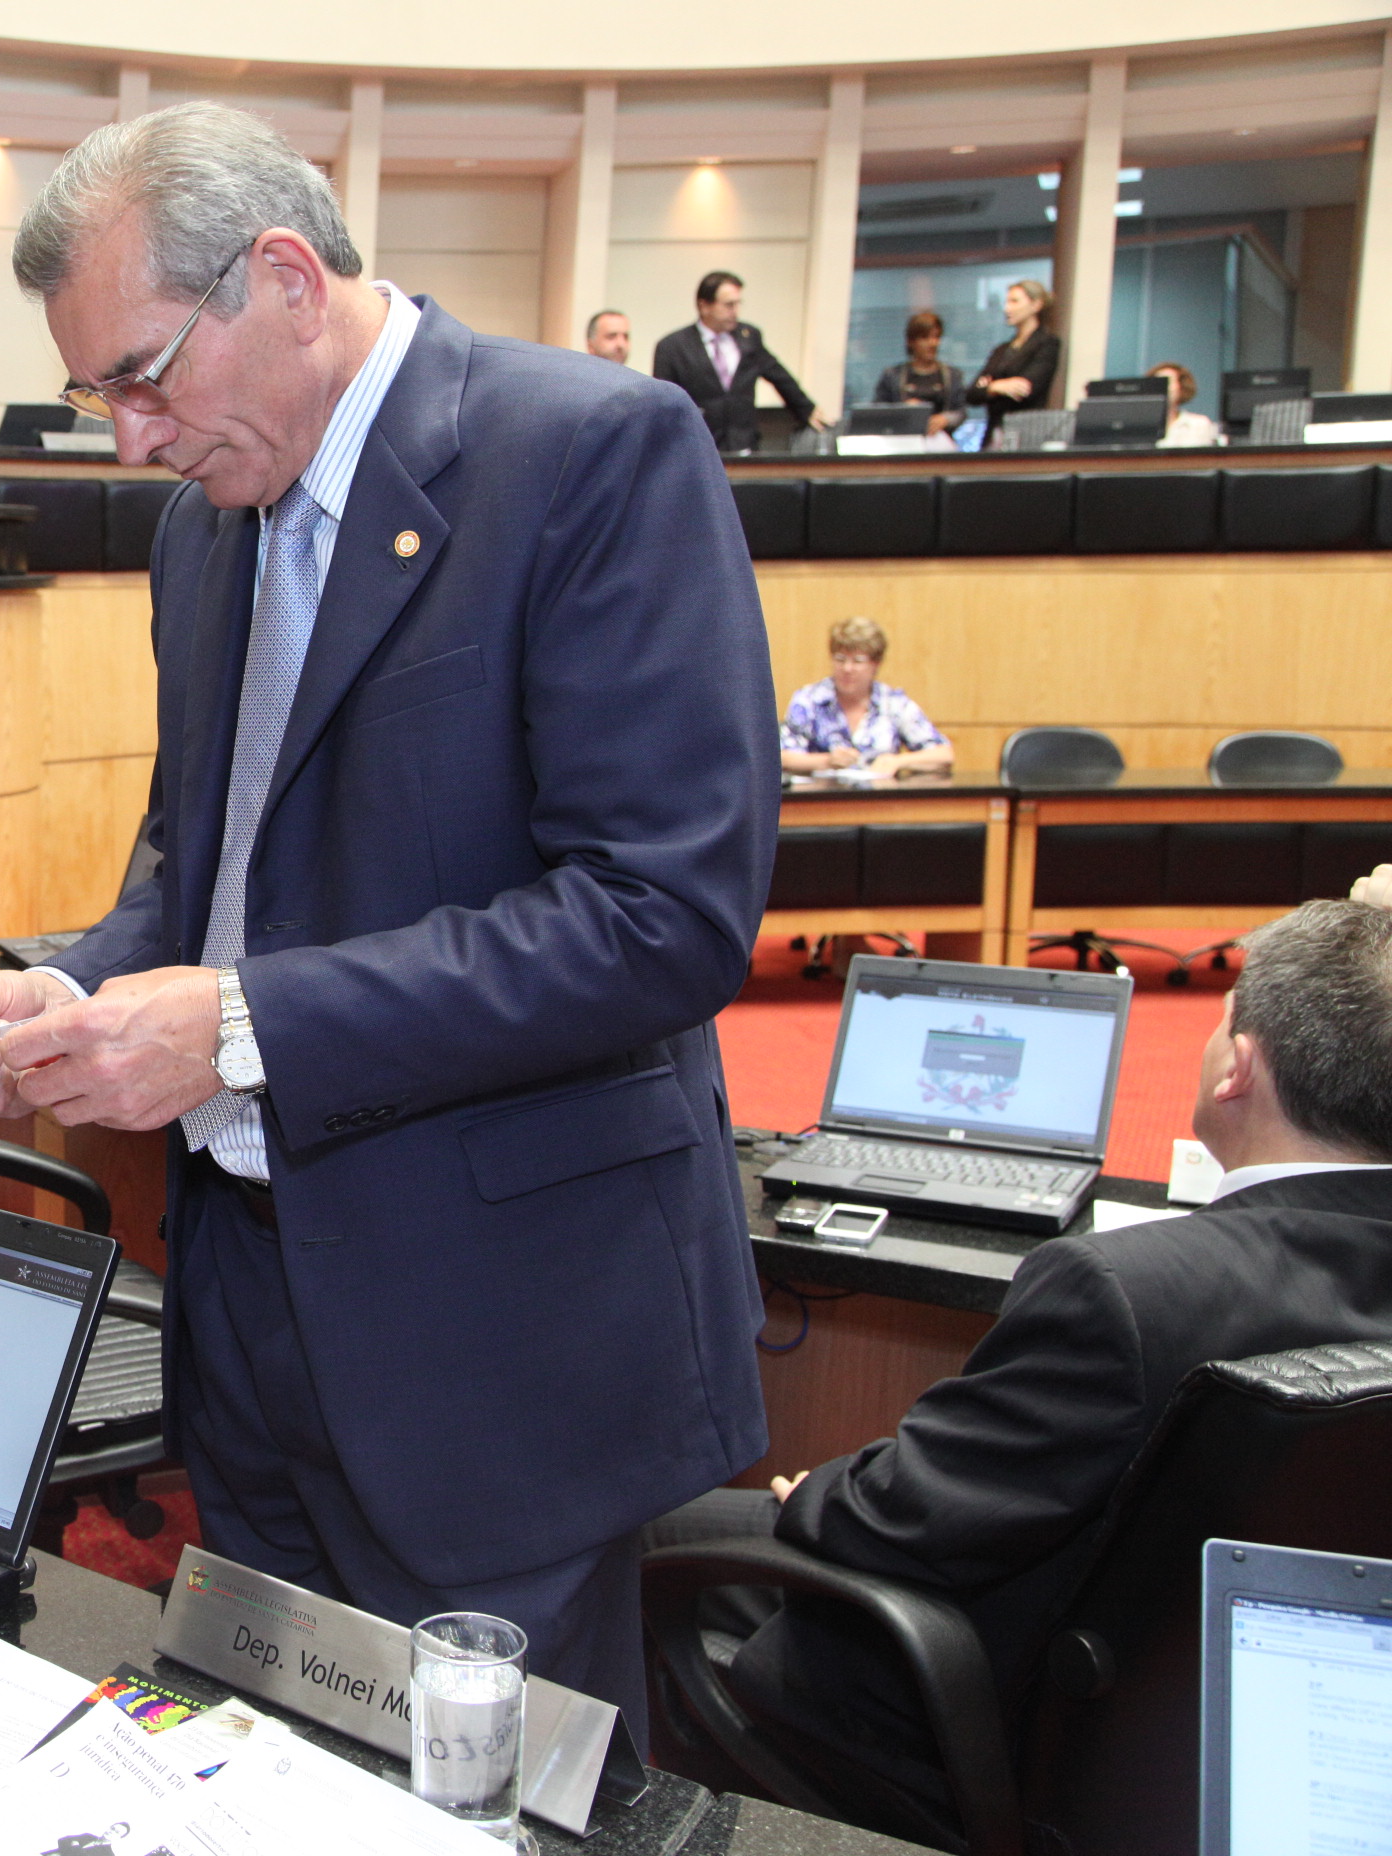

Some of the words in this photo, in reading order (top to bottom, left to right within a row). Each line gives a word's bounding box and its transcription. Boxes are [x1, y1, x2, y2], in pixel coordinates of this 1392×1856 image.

[213, 1578, 264, 1604] ASSEMBLÉIA
[263, 1598, 319, 1624] LEGISLATIVA
[279, 1619, 314, 1636] CATARINA
[232, 1624, 284, 1671] Dep.
[300, 1650, 378, 1706] Volnei
[127, 1675, 209, 1710] MOVIMENTO
[95, 1733, 104, 1742] e
[102, 1738, 166, 1800] insegurança
[112, 1721, 136, 1749] Ação
[132, 1745, 169, 1775] penal
